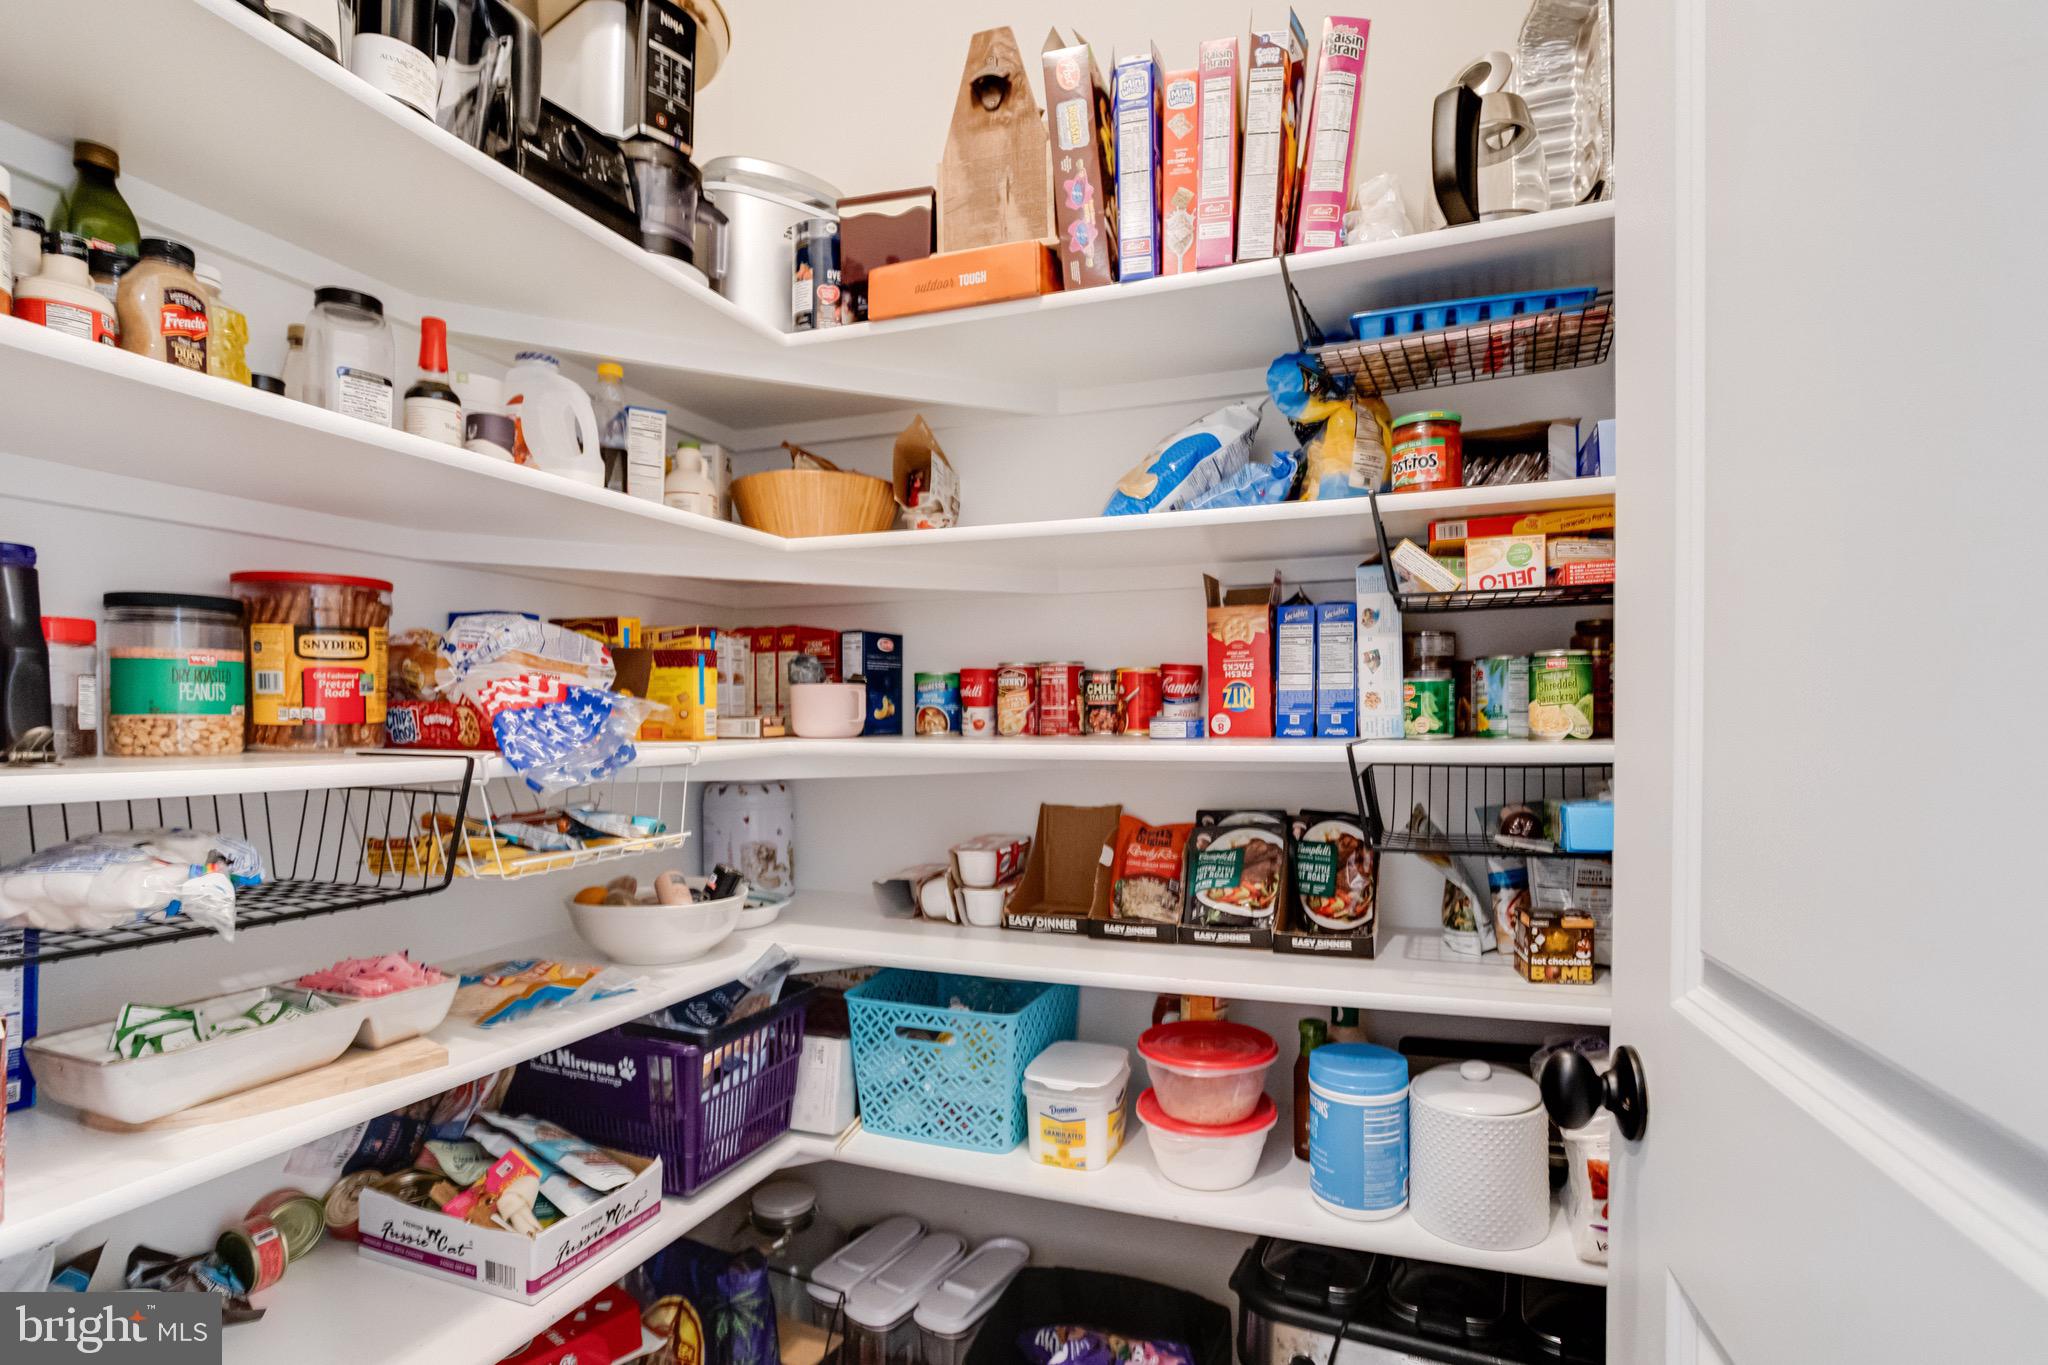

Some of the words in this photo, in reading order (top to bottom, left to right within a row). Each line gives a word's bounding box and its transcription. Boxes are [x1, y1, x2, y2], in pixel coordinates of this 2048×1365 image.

[660, 9, 684, 35] NINJA
[1328, 44, 1359, 59] Bran
[1123, 76, 1146, 91] Mini
[1169, 87, 1193, 101] Mini
[914, 278, 956, 295] outdoor
[958, 270, 987, 287] TOUGH
[1393, 453, 1438, 474] OSTITOS
[1222, 662, 1255, 671] STACKS
[171, 667, 191, 683] DRY
[1225, 669, 1253, 679] FRESH
[318, 678, 356, 690] Pretzel
[1538, 679, 1578, 691] Shredded
[178, 682, 226, 702] PEANUTS
[324, 687, 351, 699] Rods
[1222, 686, 1255, 709] RITZ
[1008, 915, 1035, 928] EASY
[1036, 916, 1077, 930] DINNER
[1104, 923, 1125, 935] EASY
[1124, 924, 1157, 937] DINNER
[1194, 930, 1217, 941] EASY
[1216, 932, 1251, 943] DINNER
[1291, 937, 1316, 949] EASY
[1315, 938, 1352, 950] DINNER
[1531, 957, 1547, 966] hot
[1548, 957, 1592, 966] chocolate
[556, 1048, 616, 1076] Nirvana
[1048, 1104, 1078, 1115] Domino
[1043, 1128, 1083, 1140] GRANULATED
[437, 1236, 473, 1257] Cat
